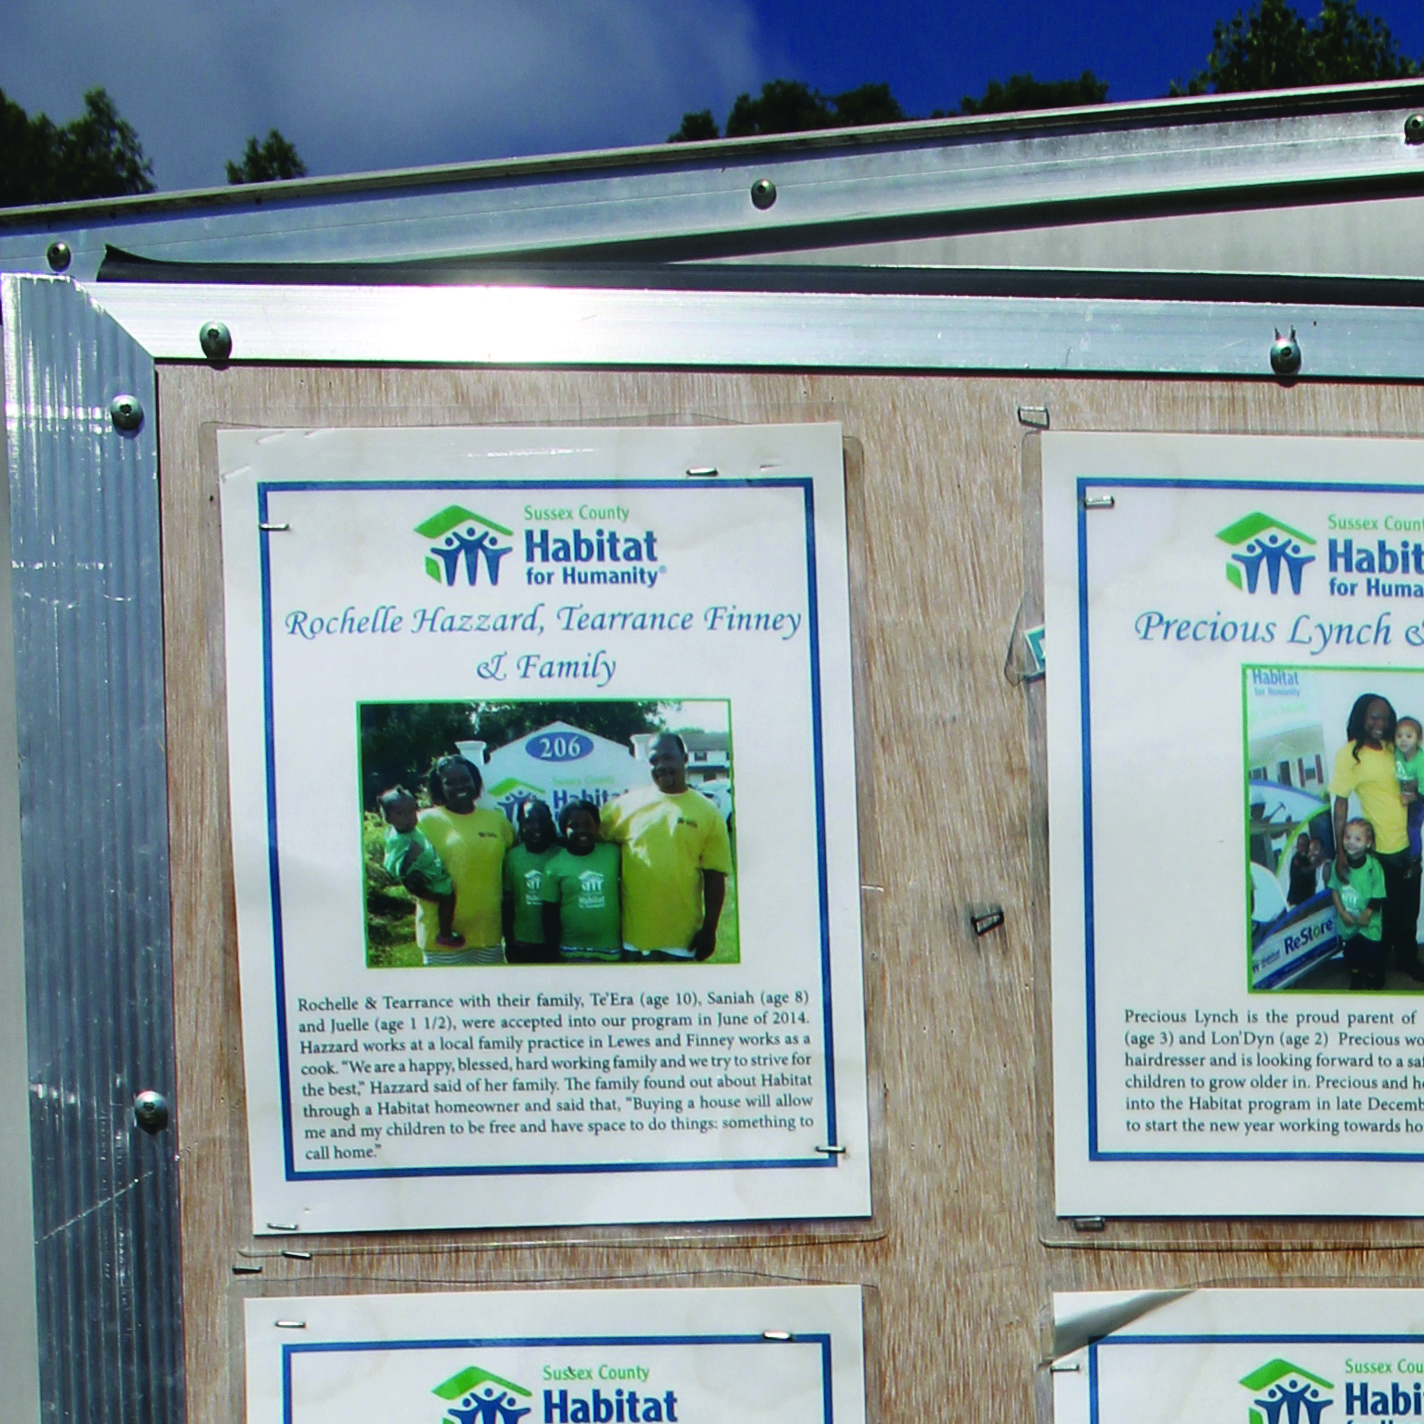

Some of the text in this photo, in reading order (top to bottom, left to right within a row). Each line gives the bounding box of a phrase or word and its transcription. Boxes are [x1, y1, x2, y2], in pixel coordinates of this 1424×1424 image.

[524, 505, 629, 522] Sussex County
[1328, 514, 1378, 530] Sussex
[525, 528, 657, 562] Habitat
[526, 567, 554, 585] for
[1329, 577, 1358, 596] for
[285, 603, 801, 640] Rochelle Hazzard, Tearrance Finney
[1135, 610, 1276, 643] Precious
[1287, 611, 1391, 655] Lynch
[516, 650, 616, 687] Family
[1252, 669, 1298, 685] Habitat
[540, 736, 580, 758] 206
[1284, 918, 1334, 955] ReStore
[1126, 1120, 1140, 1131] to
[1146, 1120, 1177, 1131] start
[1182, 1117, 1205, 1131] the
[1210, 1122, 1240, 1131] new
[1244, 1122, 1275, 1136] year
[1279, 1117, 1339, 1136] working
[1344, 1118, 1401, 1132] towards
[306, 1146, 329, 1159] call
[543, 1364, 649, 1382] Sussex County
[1345, 1359, 1391, 1373] Sussex
[543, 1388, 678, 1424] Habitat
